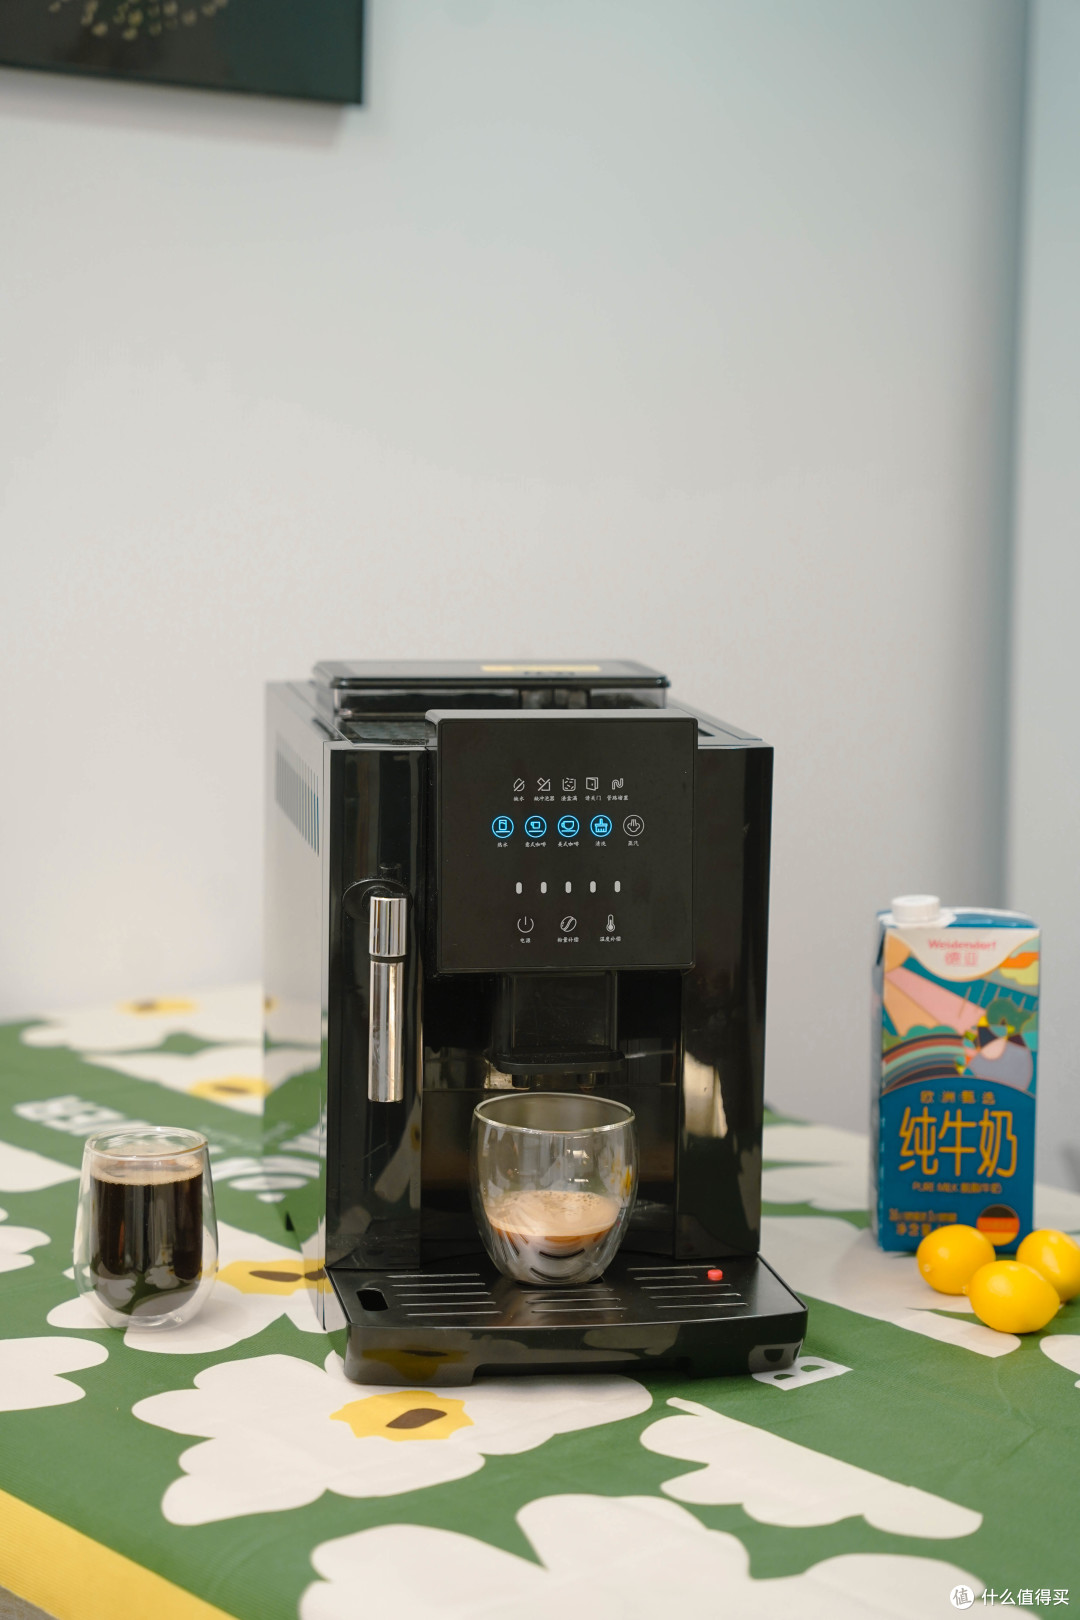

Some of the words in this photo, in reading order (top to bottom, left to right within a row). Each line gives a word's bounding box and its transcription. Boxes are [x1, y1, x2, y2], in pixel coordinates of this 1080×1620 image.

[928, 939, 997, 950] Weidendorf
[920, 1090, 996, 1105] 欧洲甄选
[898, 1106, 1018, 1178] 纯牛奶
[912, 1181, 934, 1192] PURE
[937, 1182, 958, 1193] MILK
